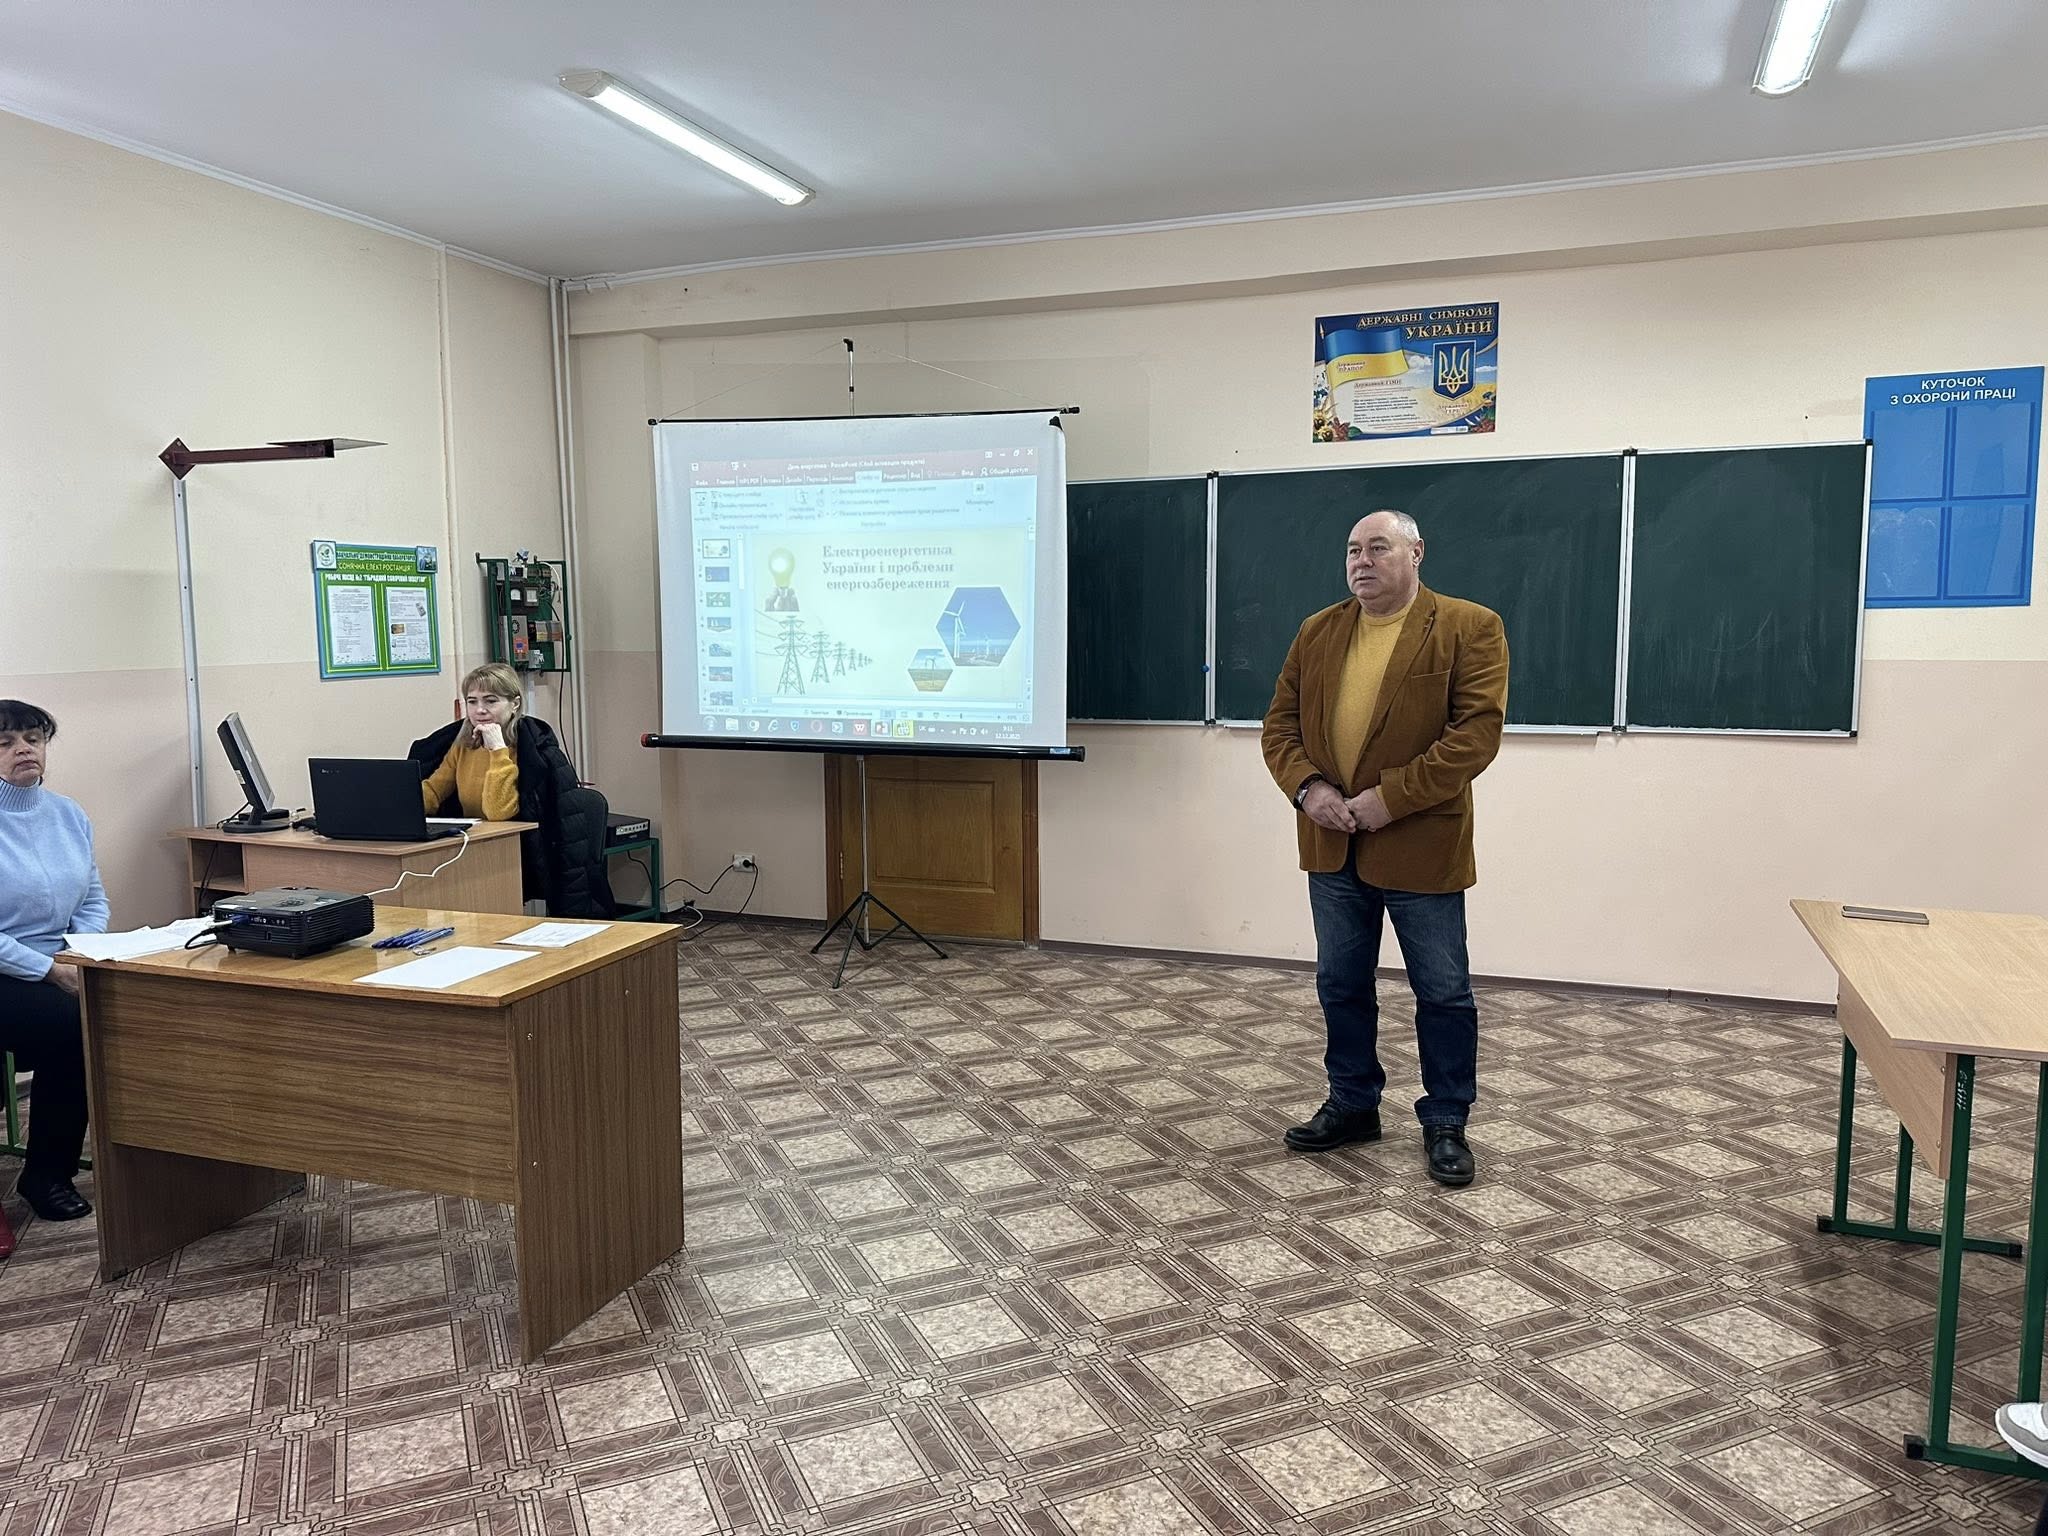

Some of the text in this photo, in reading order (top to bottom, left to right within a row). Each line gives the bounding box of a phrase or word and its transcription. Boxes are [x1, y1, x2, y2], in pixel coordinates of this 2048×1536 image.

[1357, 306, 1493, 328] ДЕРЖАВНІ СИМВОЛИ
[1405, 320, 1493, 340] УКРАЇНИ
[1921, 376, 1986, 390] КУТОЧОК
[1890, 388, 2016, 405] З ОХОРОНИ ПРАЦІ
[823, 544, 953, 559] Електроенергетика
[822, 559, 954, 575] України і проблеми
[826, 577, 950, 592] енергозбереження
